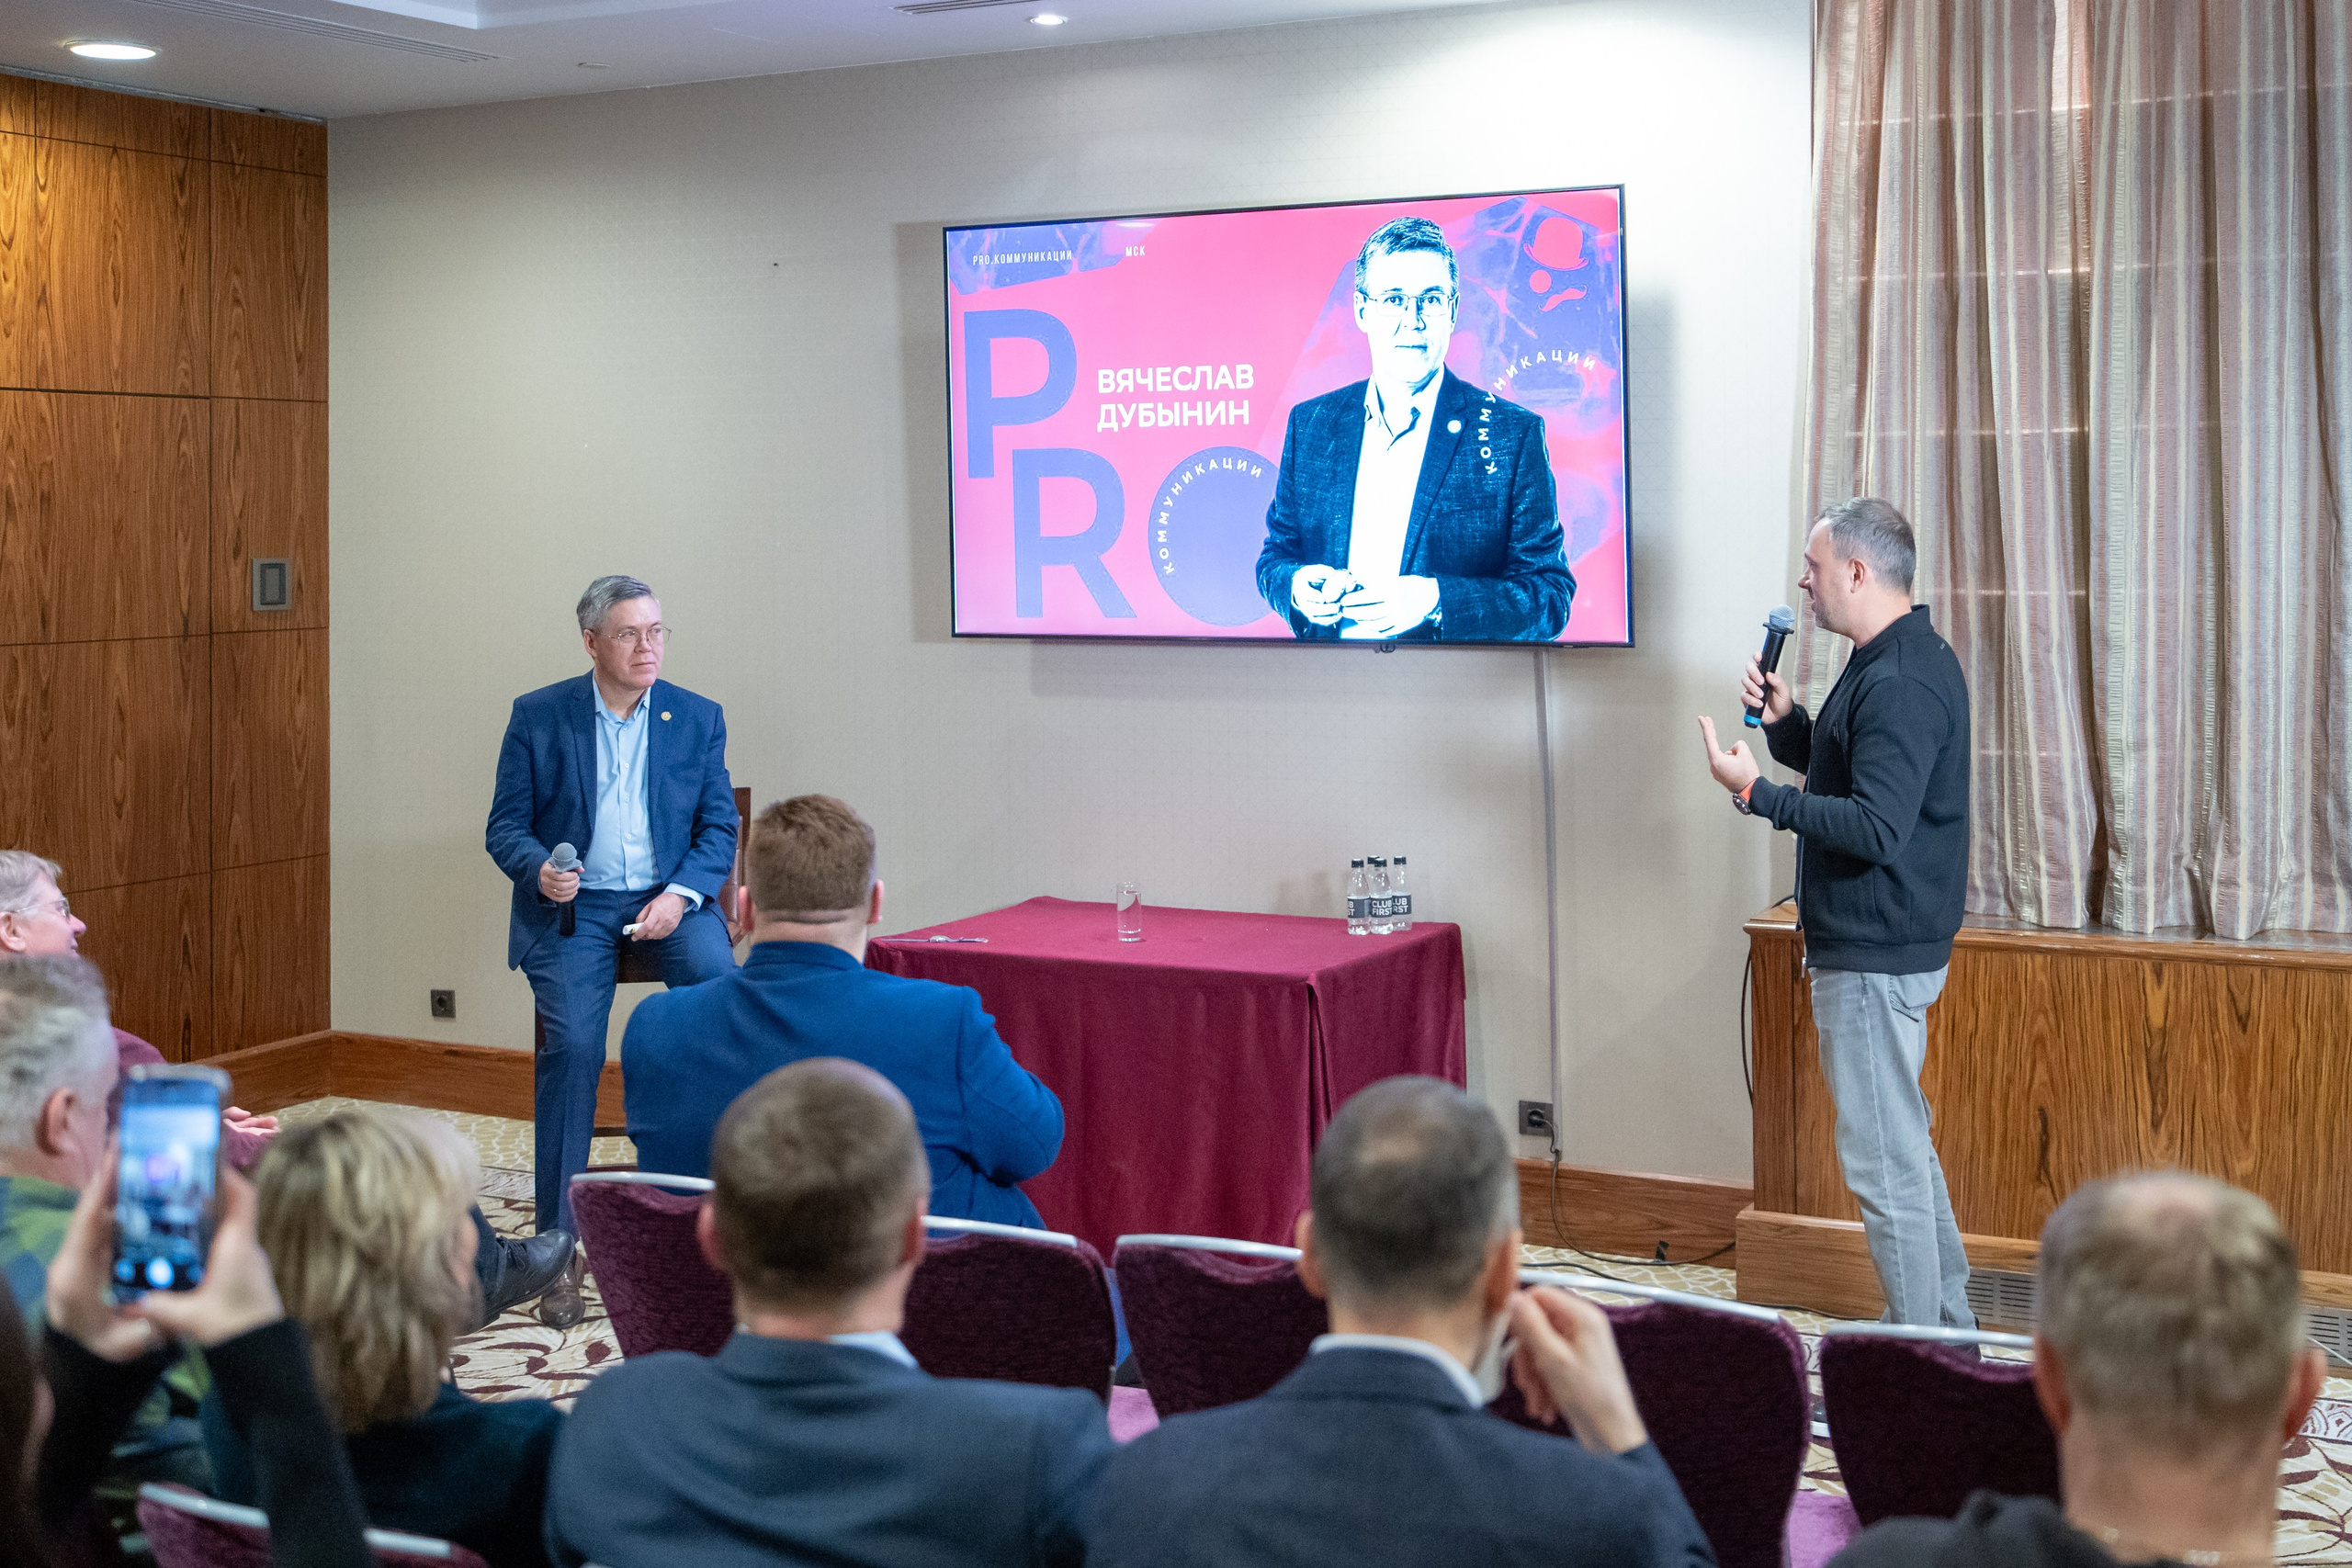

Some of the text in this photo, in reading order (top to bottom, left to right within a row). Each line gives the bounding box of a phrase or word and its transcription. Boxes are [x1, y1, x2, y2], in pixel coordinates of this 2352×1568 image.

[972, 245, 1146, 266] PRO.КОММУНИКАЦИИ МСК
[1097, 364, 1255, 394] ВЯЧЕСЛАВ
[1096, 400, 1250, 433] ДУБЫНИН
[1477, 349, 1596, 475] КОММУНИКАЦИИ
[1157, 457, 1263, 574] КОММУНИКАЦИИ
[1372, 900, 1393, 908] CLUB
